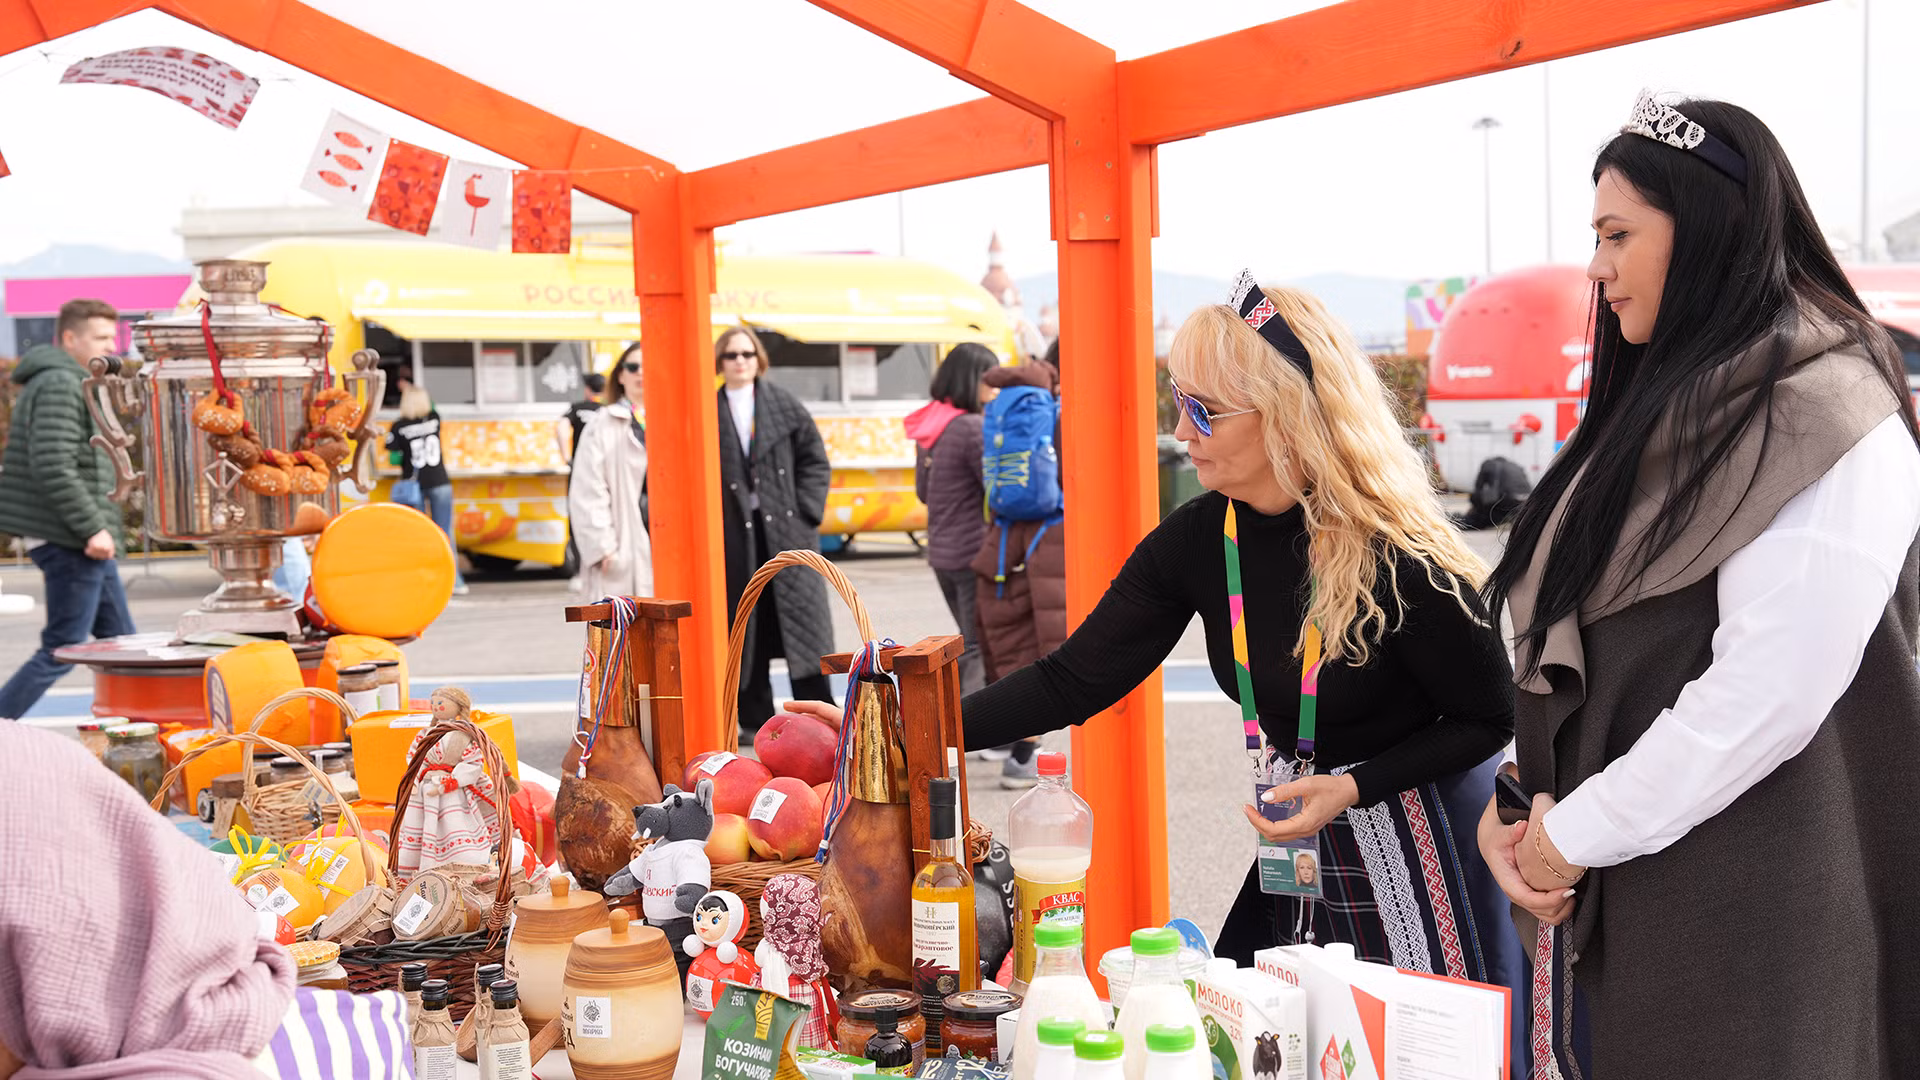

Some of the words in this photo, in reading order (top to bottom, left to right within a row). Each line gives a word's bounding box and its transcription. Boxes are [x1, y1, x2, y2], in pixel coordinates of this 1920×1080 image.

[1052, 892, 1080, 905] КВАС
[731, 996, 744, 1007] 250
[1197, 983, 1243, 1018] МОЛОКО
[724, 1038, 774, 1063] КОЗИНАКИ
